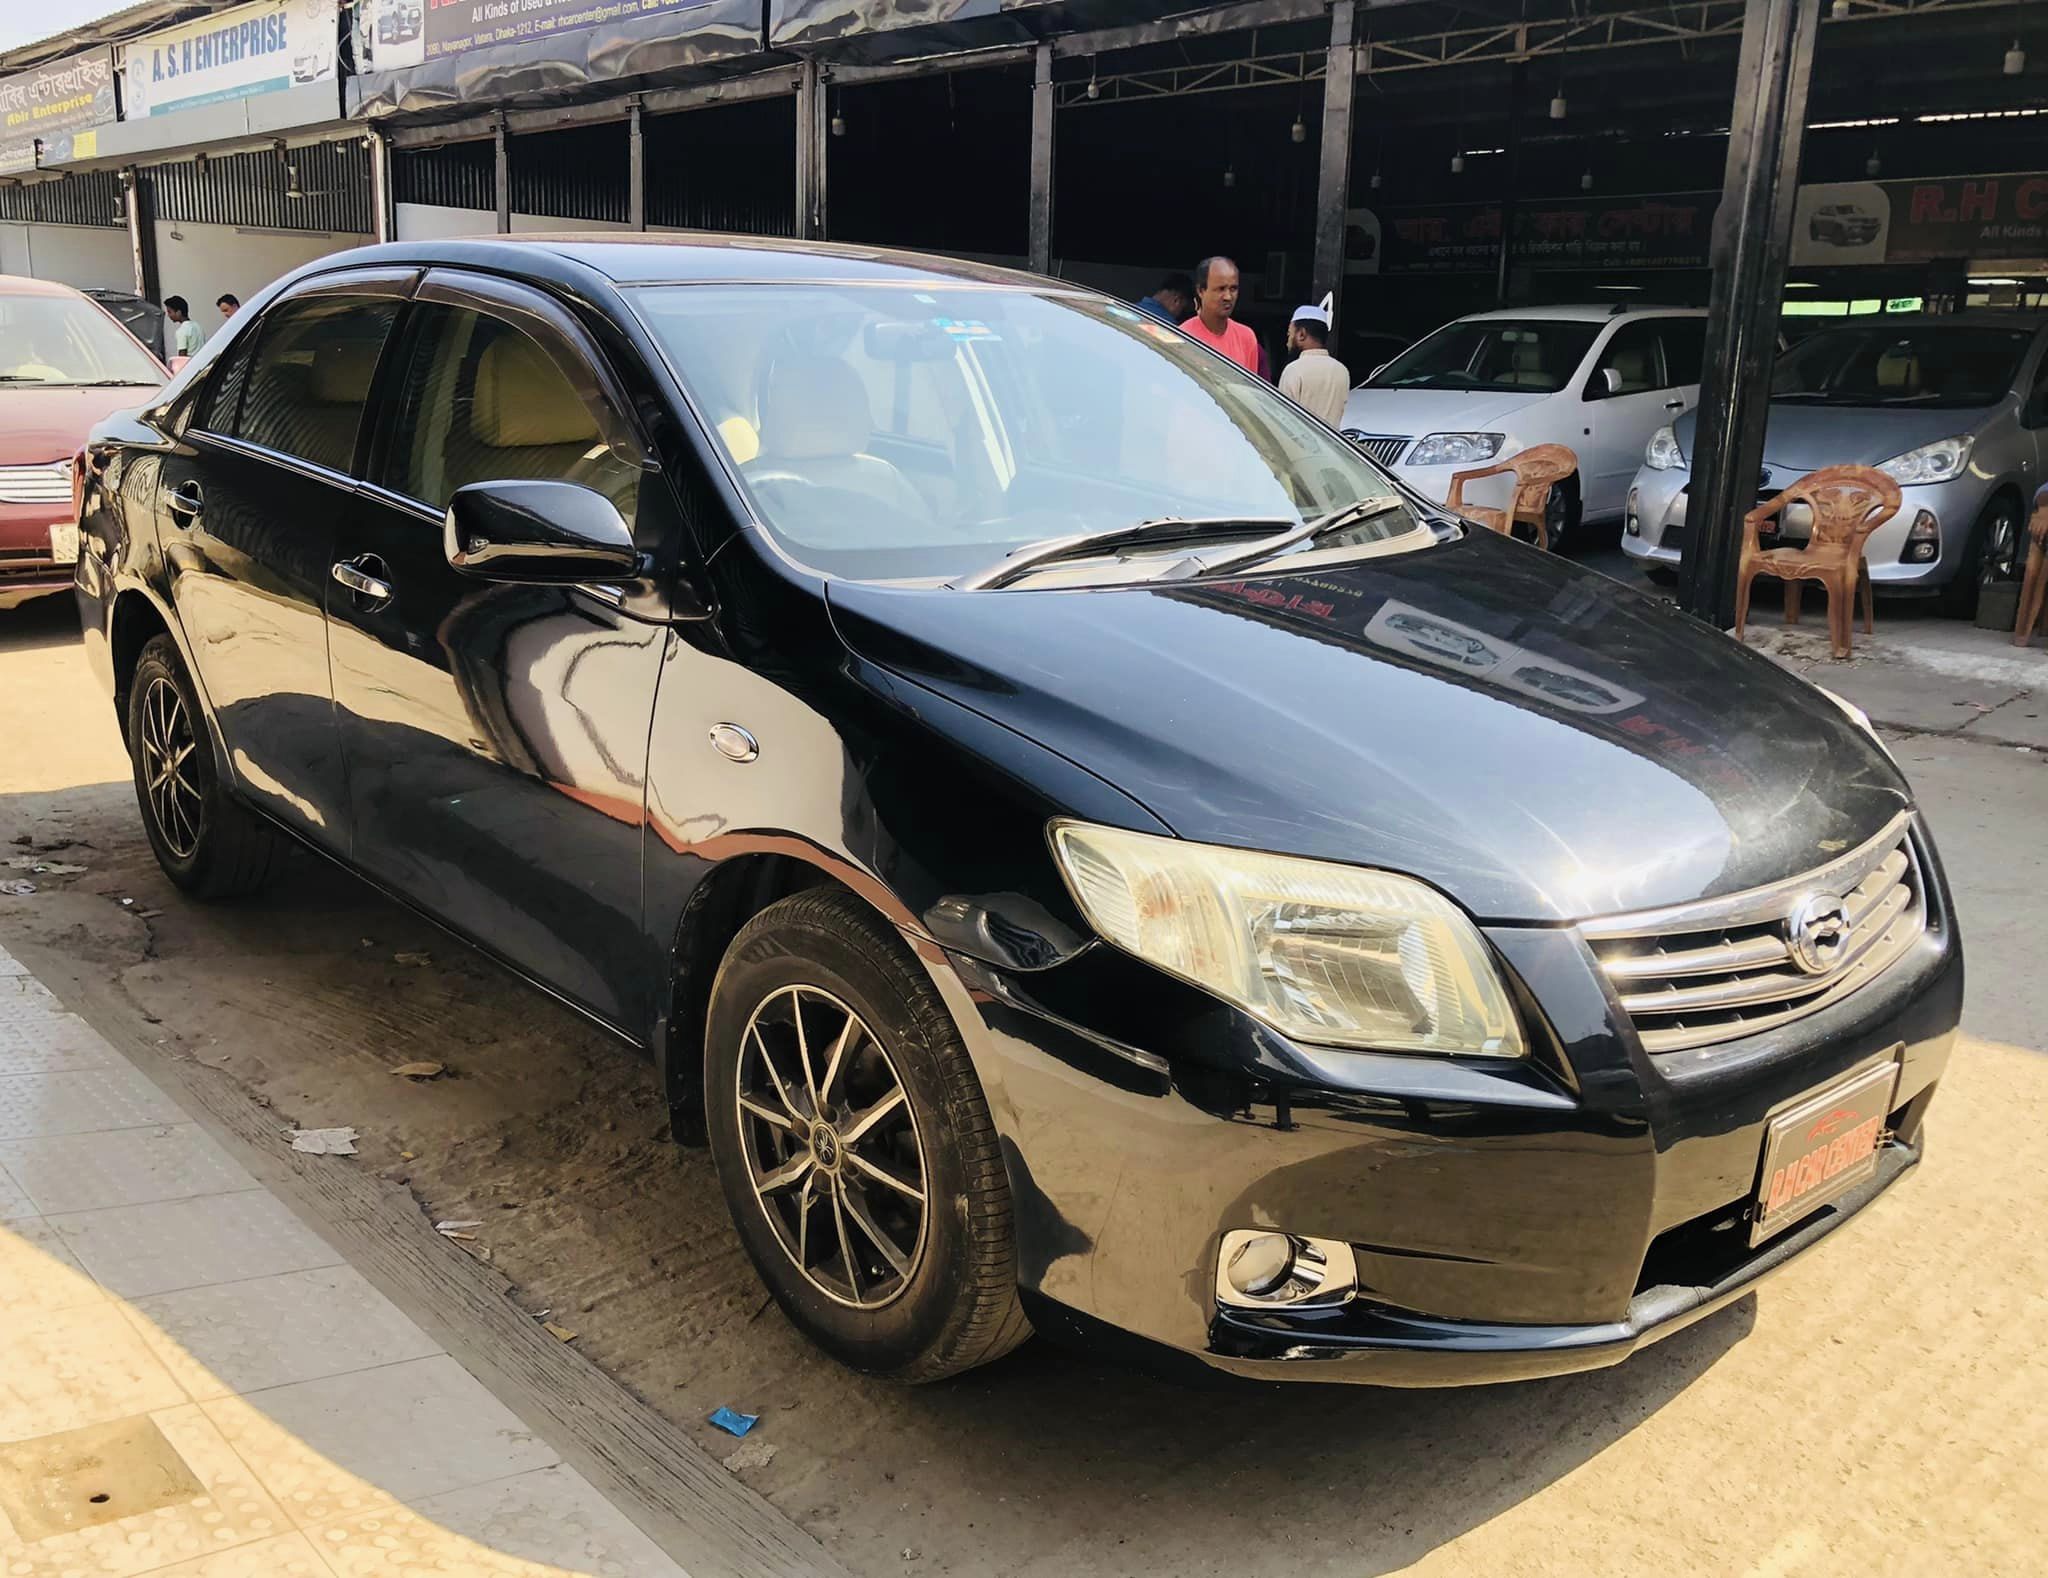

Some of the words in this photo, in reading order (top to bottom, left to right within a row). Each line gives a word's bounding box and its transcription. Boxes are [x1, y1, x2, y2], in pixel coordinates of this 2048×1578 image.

[472, 7, 483, 23] All
[485, 4, 508, 20] Kinds
[510, 0, 520, 14] of
[152, 49, 165, 82] A.
[167, 44, 180, 78] S.
[182, 39, 192, 74] H
[195, 12, 288, 71] ENTERPRISE
[7, 111, 30, 127] Abir
[32, 93, 93, 119] Enterprise
[1910, 180, 2000, 224] R.H
[1979, 225, 2001, 240] All
[2003, 223, 2042, 238] Kinds
